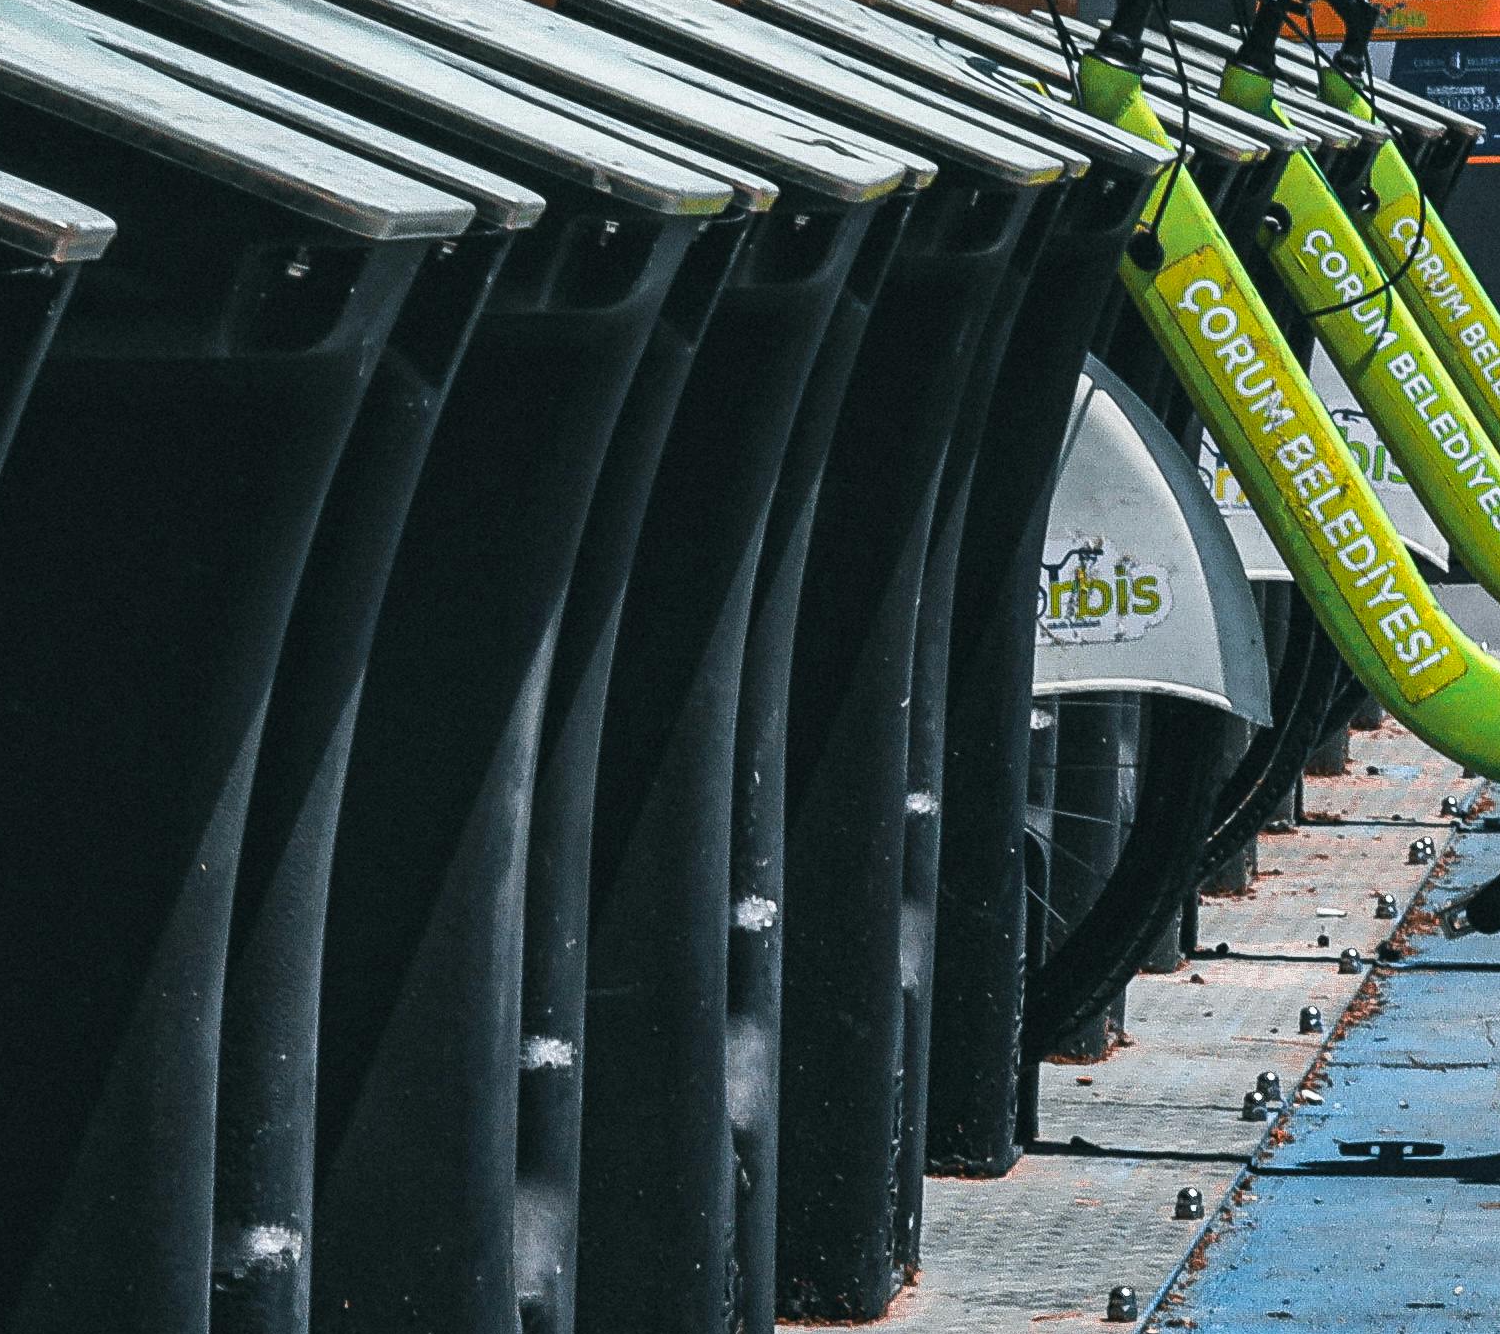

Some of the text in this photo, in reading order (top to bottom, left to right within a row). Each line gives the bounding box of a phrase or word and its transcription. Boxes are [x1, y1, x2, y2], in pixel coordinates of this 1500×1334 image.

[1301, 229, 1398, 351] ÇORUM
[1390, 217, 1472, 322] ÇORUM
[1177, 279, 1296, 436] ÇORUM
[1276, 433, 1451, 677] BELEDİYESİ
